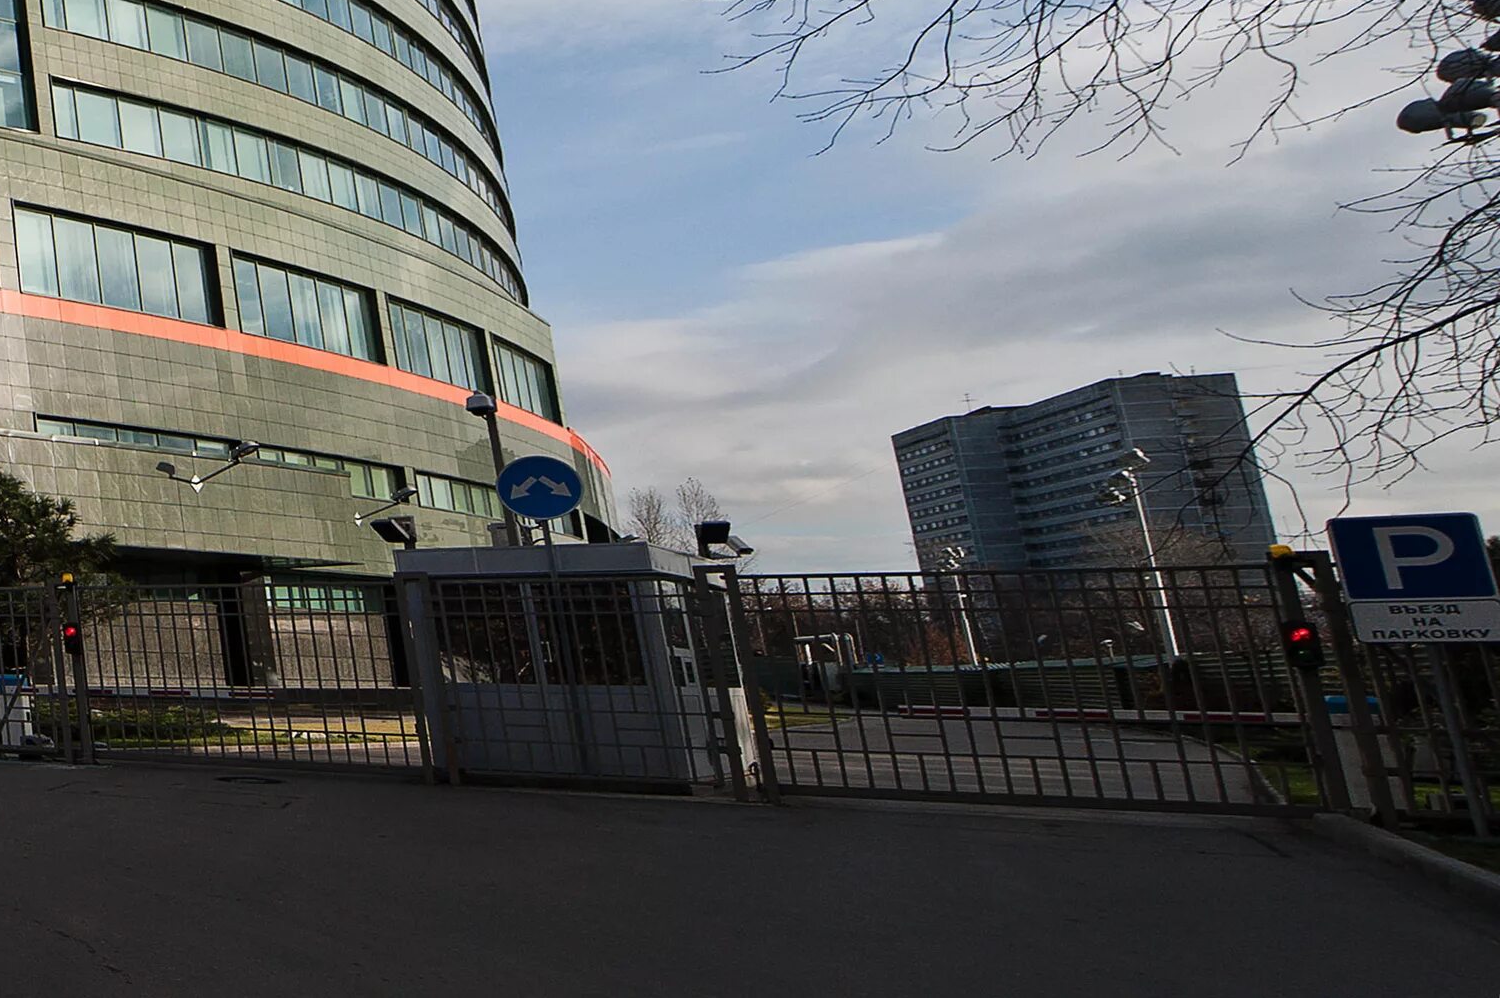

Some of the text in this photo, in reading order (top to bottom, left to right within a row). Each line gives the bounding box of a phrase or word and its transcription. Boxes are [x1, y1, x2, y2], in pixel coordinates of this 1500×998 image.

[1372, 525, 1455, 590] P
[1388, 604, 1461, 615] ВЪЕЗД
[1412, 616, 1443, 627] НА
[1371, 628, 1491, 640] ПАРКОВКУ
